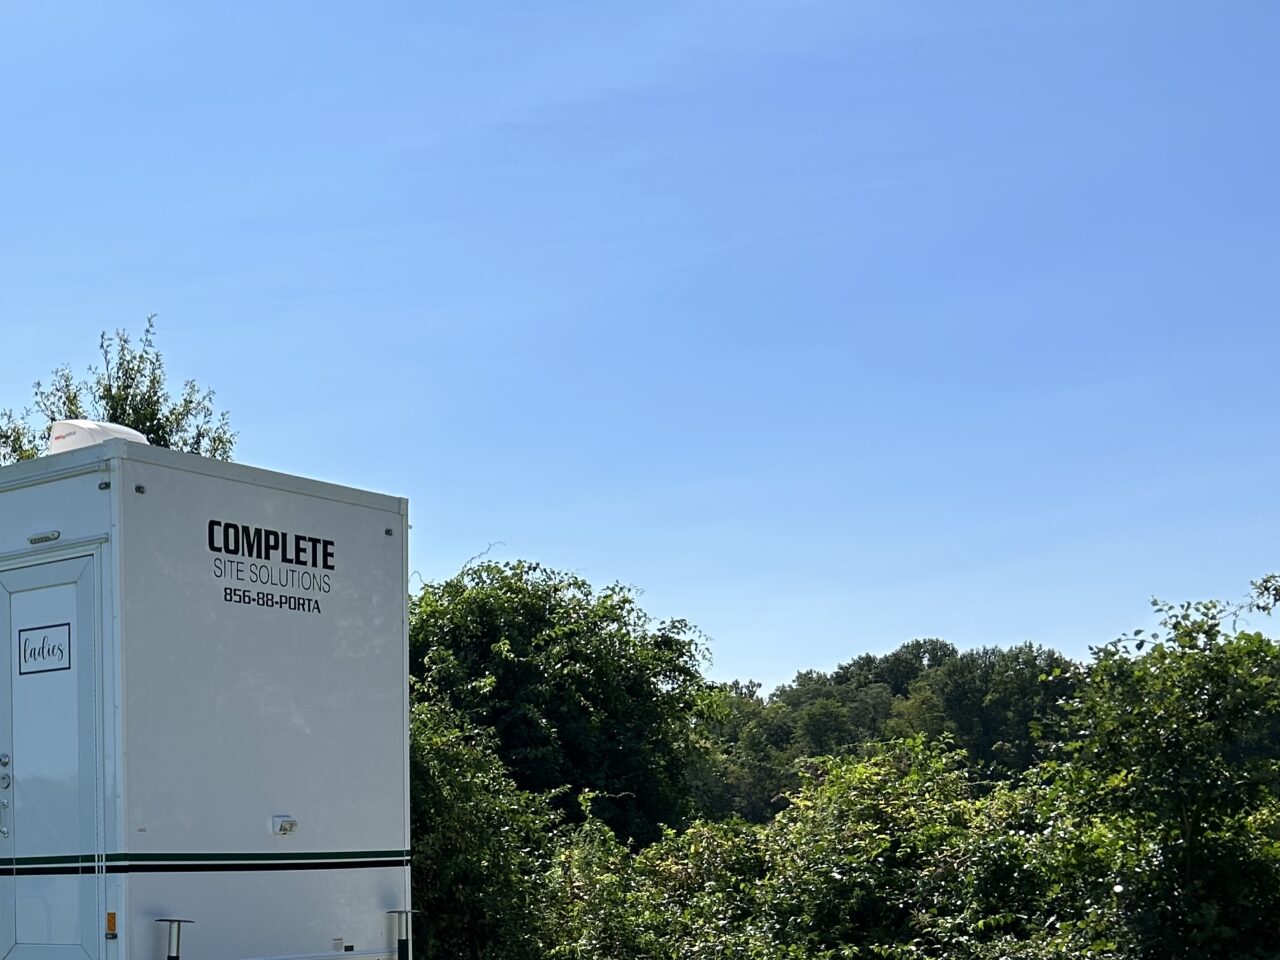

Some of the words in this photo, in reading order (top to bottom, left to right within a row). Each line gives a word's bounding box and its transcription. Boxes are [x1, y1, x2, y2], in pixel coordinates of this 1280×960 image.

[208, 519, 335, 570] COMPLETE
[213, 557, 245, 581] SITE
[249, 563, 331, 593] SOLUTIONS
[223, 587, 321, 613] 856-88-PORTA
[23, 635, 65, 663] ladies
